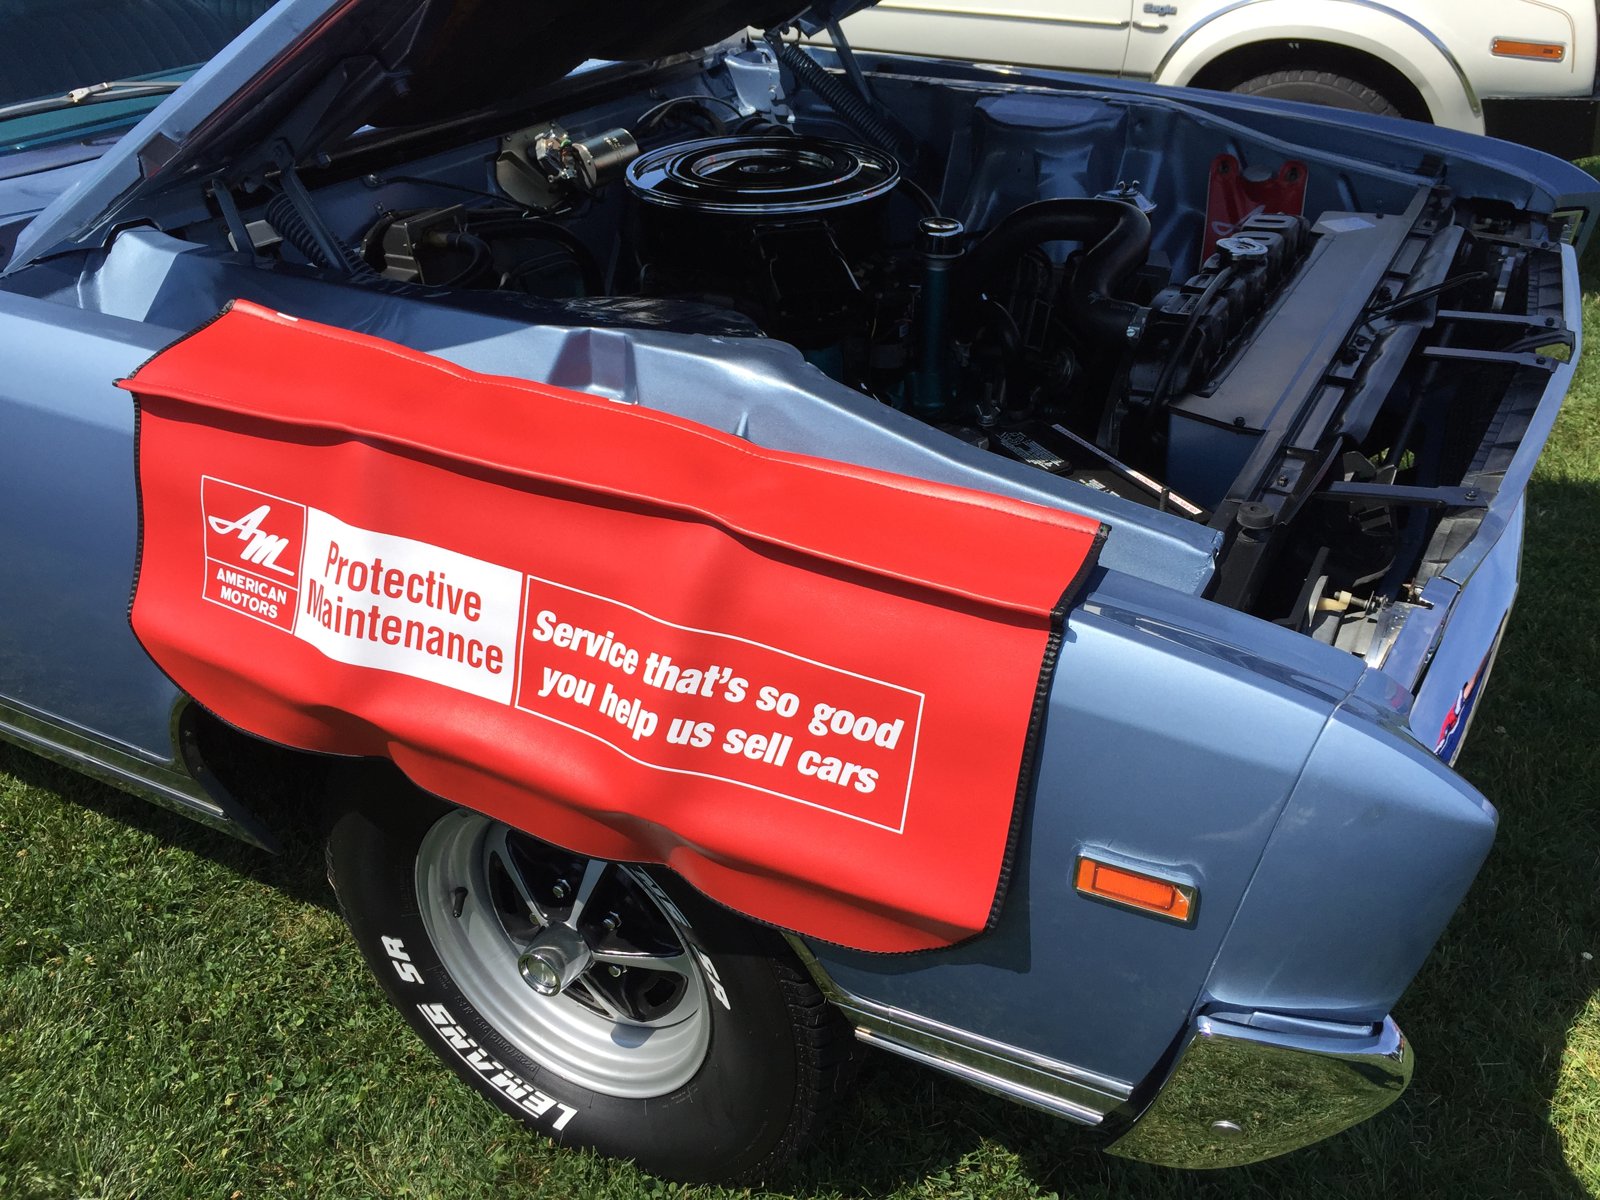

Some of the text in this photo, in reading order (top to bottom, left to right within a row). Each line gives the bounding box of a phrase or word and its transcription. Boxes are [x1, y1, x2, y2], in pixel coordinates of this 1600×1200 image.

[216, 567, 287, 605] AMERICAN
[220, 585, 278, 619] MOTORS
[306, 578, 504, 675] Maintenance
[324, 540, 482, 622] Protective
[532, 610, 905, 750] Service that's so good
[538, 666, 880, 794] you help us sell cars
[381, 935, 579, 1131] LEMANS SR
